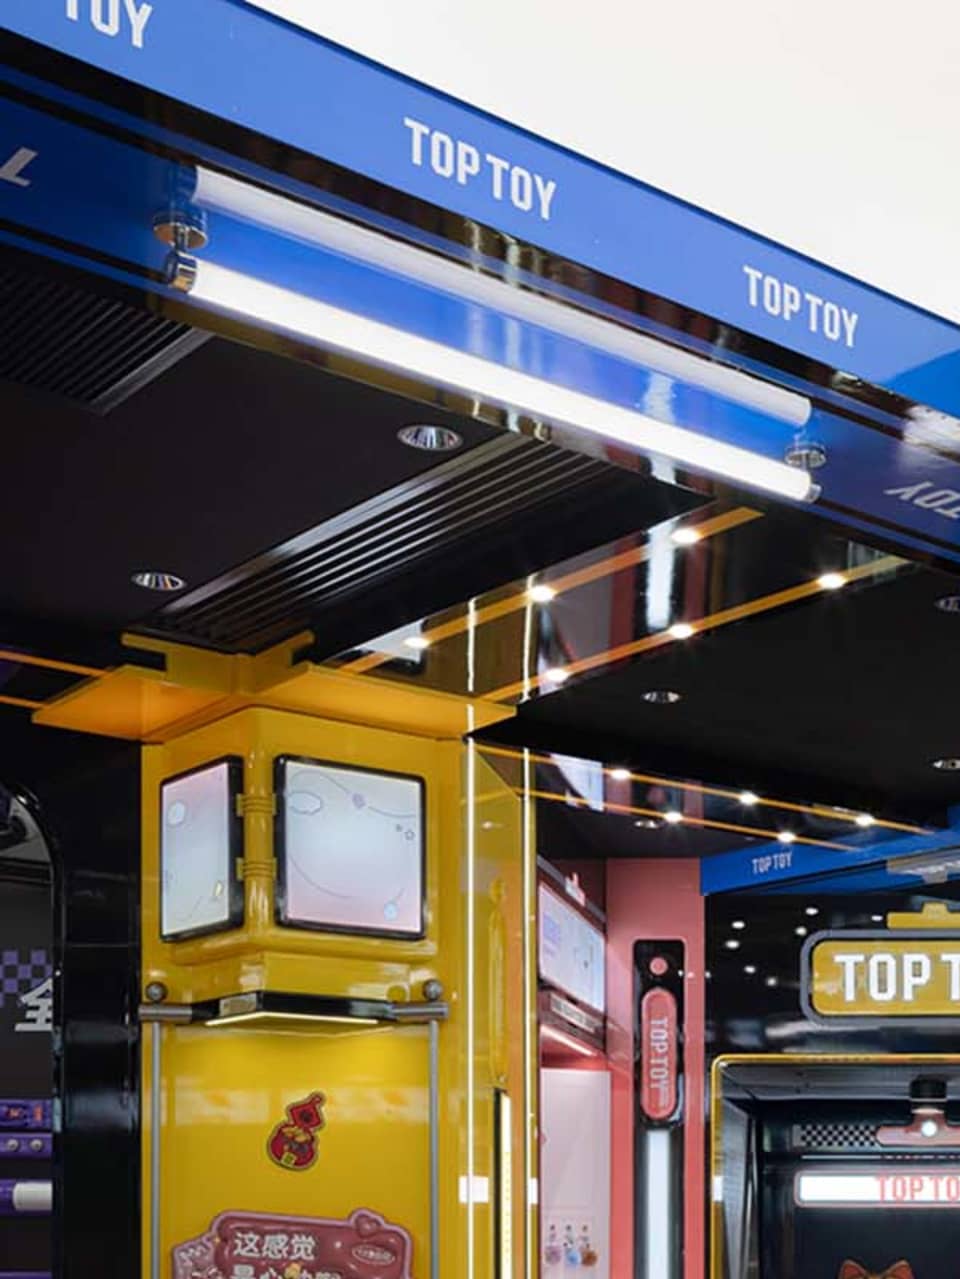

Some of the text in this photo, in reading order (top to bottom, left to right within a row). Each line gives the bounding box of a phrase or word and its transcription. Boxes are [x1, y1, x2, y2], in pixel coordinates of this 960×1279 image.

[404, 117, 557, 220] TOP TOY
[743, 265, 859, 348] TOP TOY
[752, 851, 793, 875] TOP TOY
[834, 953, 932, 1001] TOP
[650, 1017, 669, 1090] TOP TOY
[874, 1173, 924, 1201] TOP
[233, 1231, 319, 1263] 这感觉
